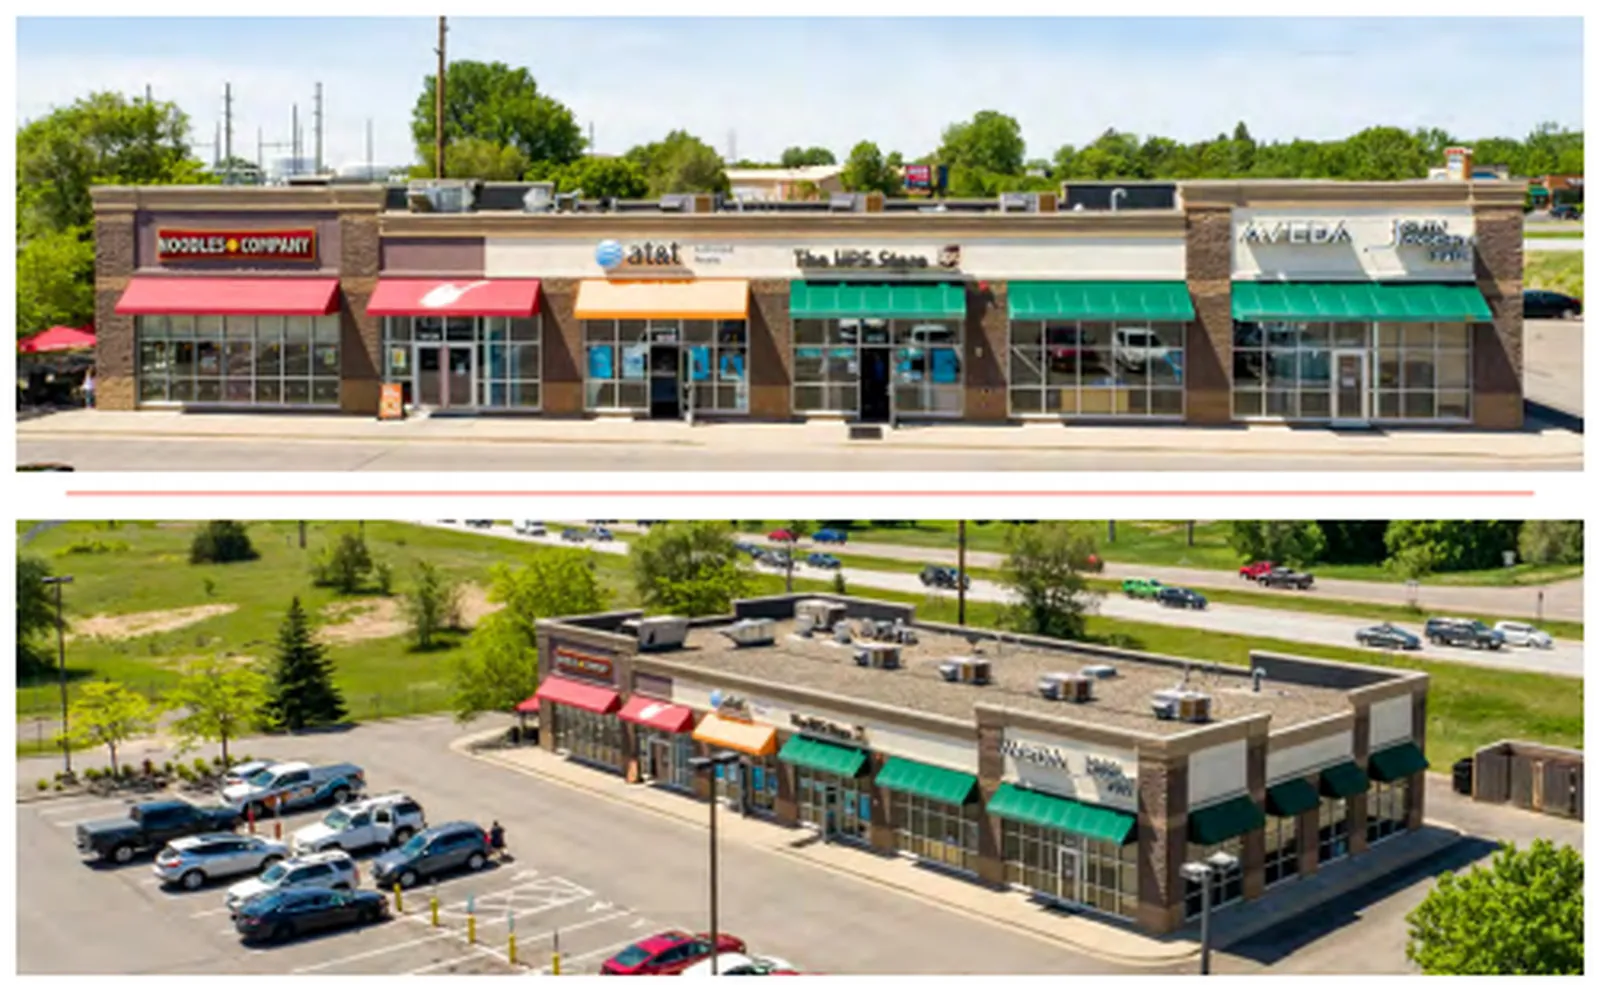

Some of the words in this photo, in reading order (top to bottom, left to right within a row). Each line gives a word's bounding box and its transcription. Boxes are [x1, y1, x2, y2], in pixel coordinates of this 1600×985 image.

[1239, 220, 1352, 243] AVEDA
[158, 236, 226, 253] NOODLES
[240, 236, 309, 253] COMPANY
[627, 242, 681, 265] at&t
[794, 249, 829, 268] The
[878, 249, 928, 268] Store
